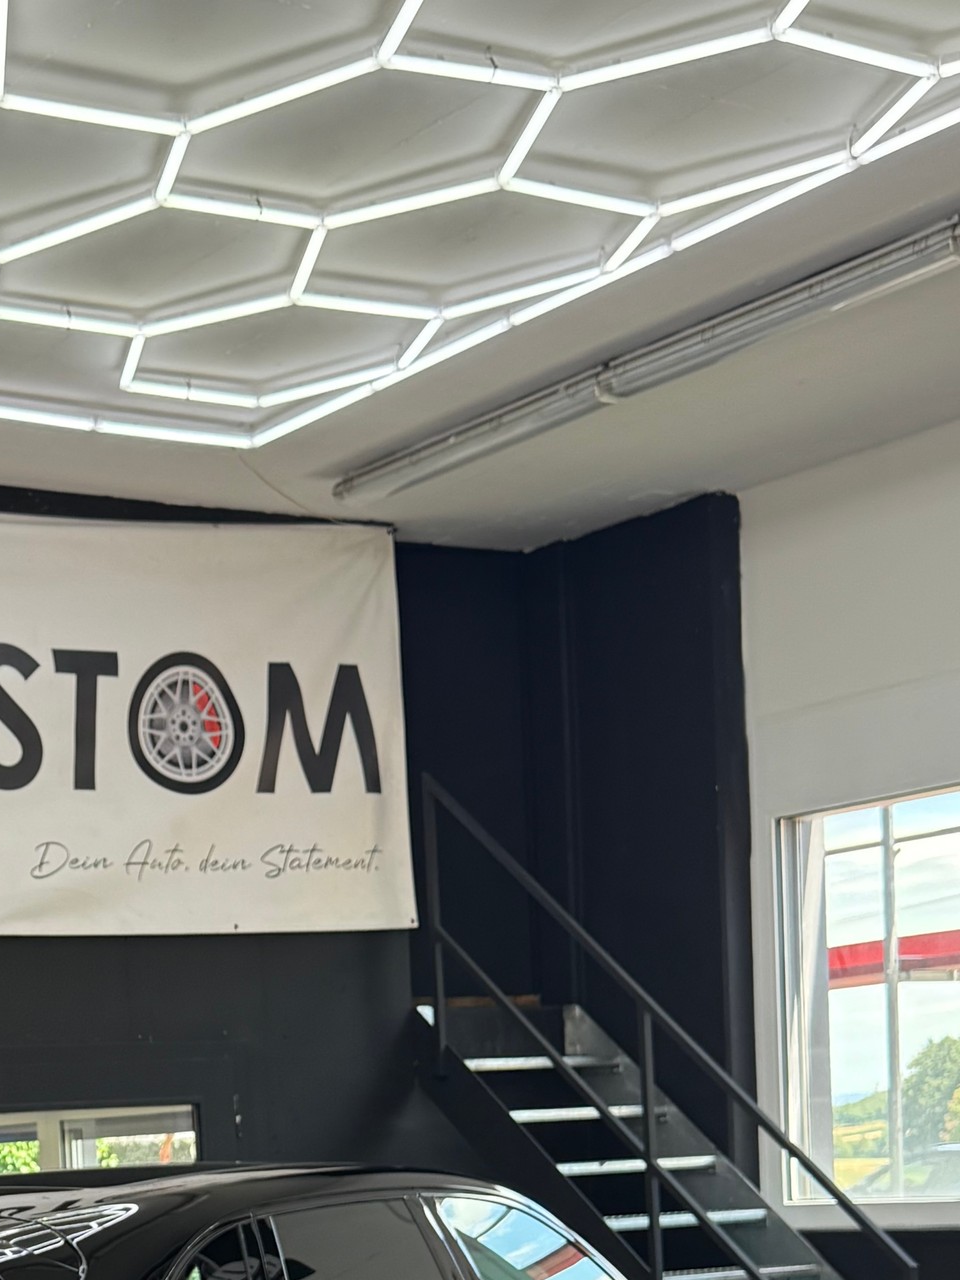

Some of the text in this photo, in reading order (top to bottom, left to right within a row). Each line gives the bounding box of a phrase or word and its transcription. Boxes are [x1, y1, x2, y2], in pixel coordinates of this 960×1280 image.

[30, 841, 113, 878] Dein
[199, 844, 252, 874] dein
[260, 843, 383, 878] Statement.
